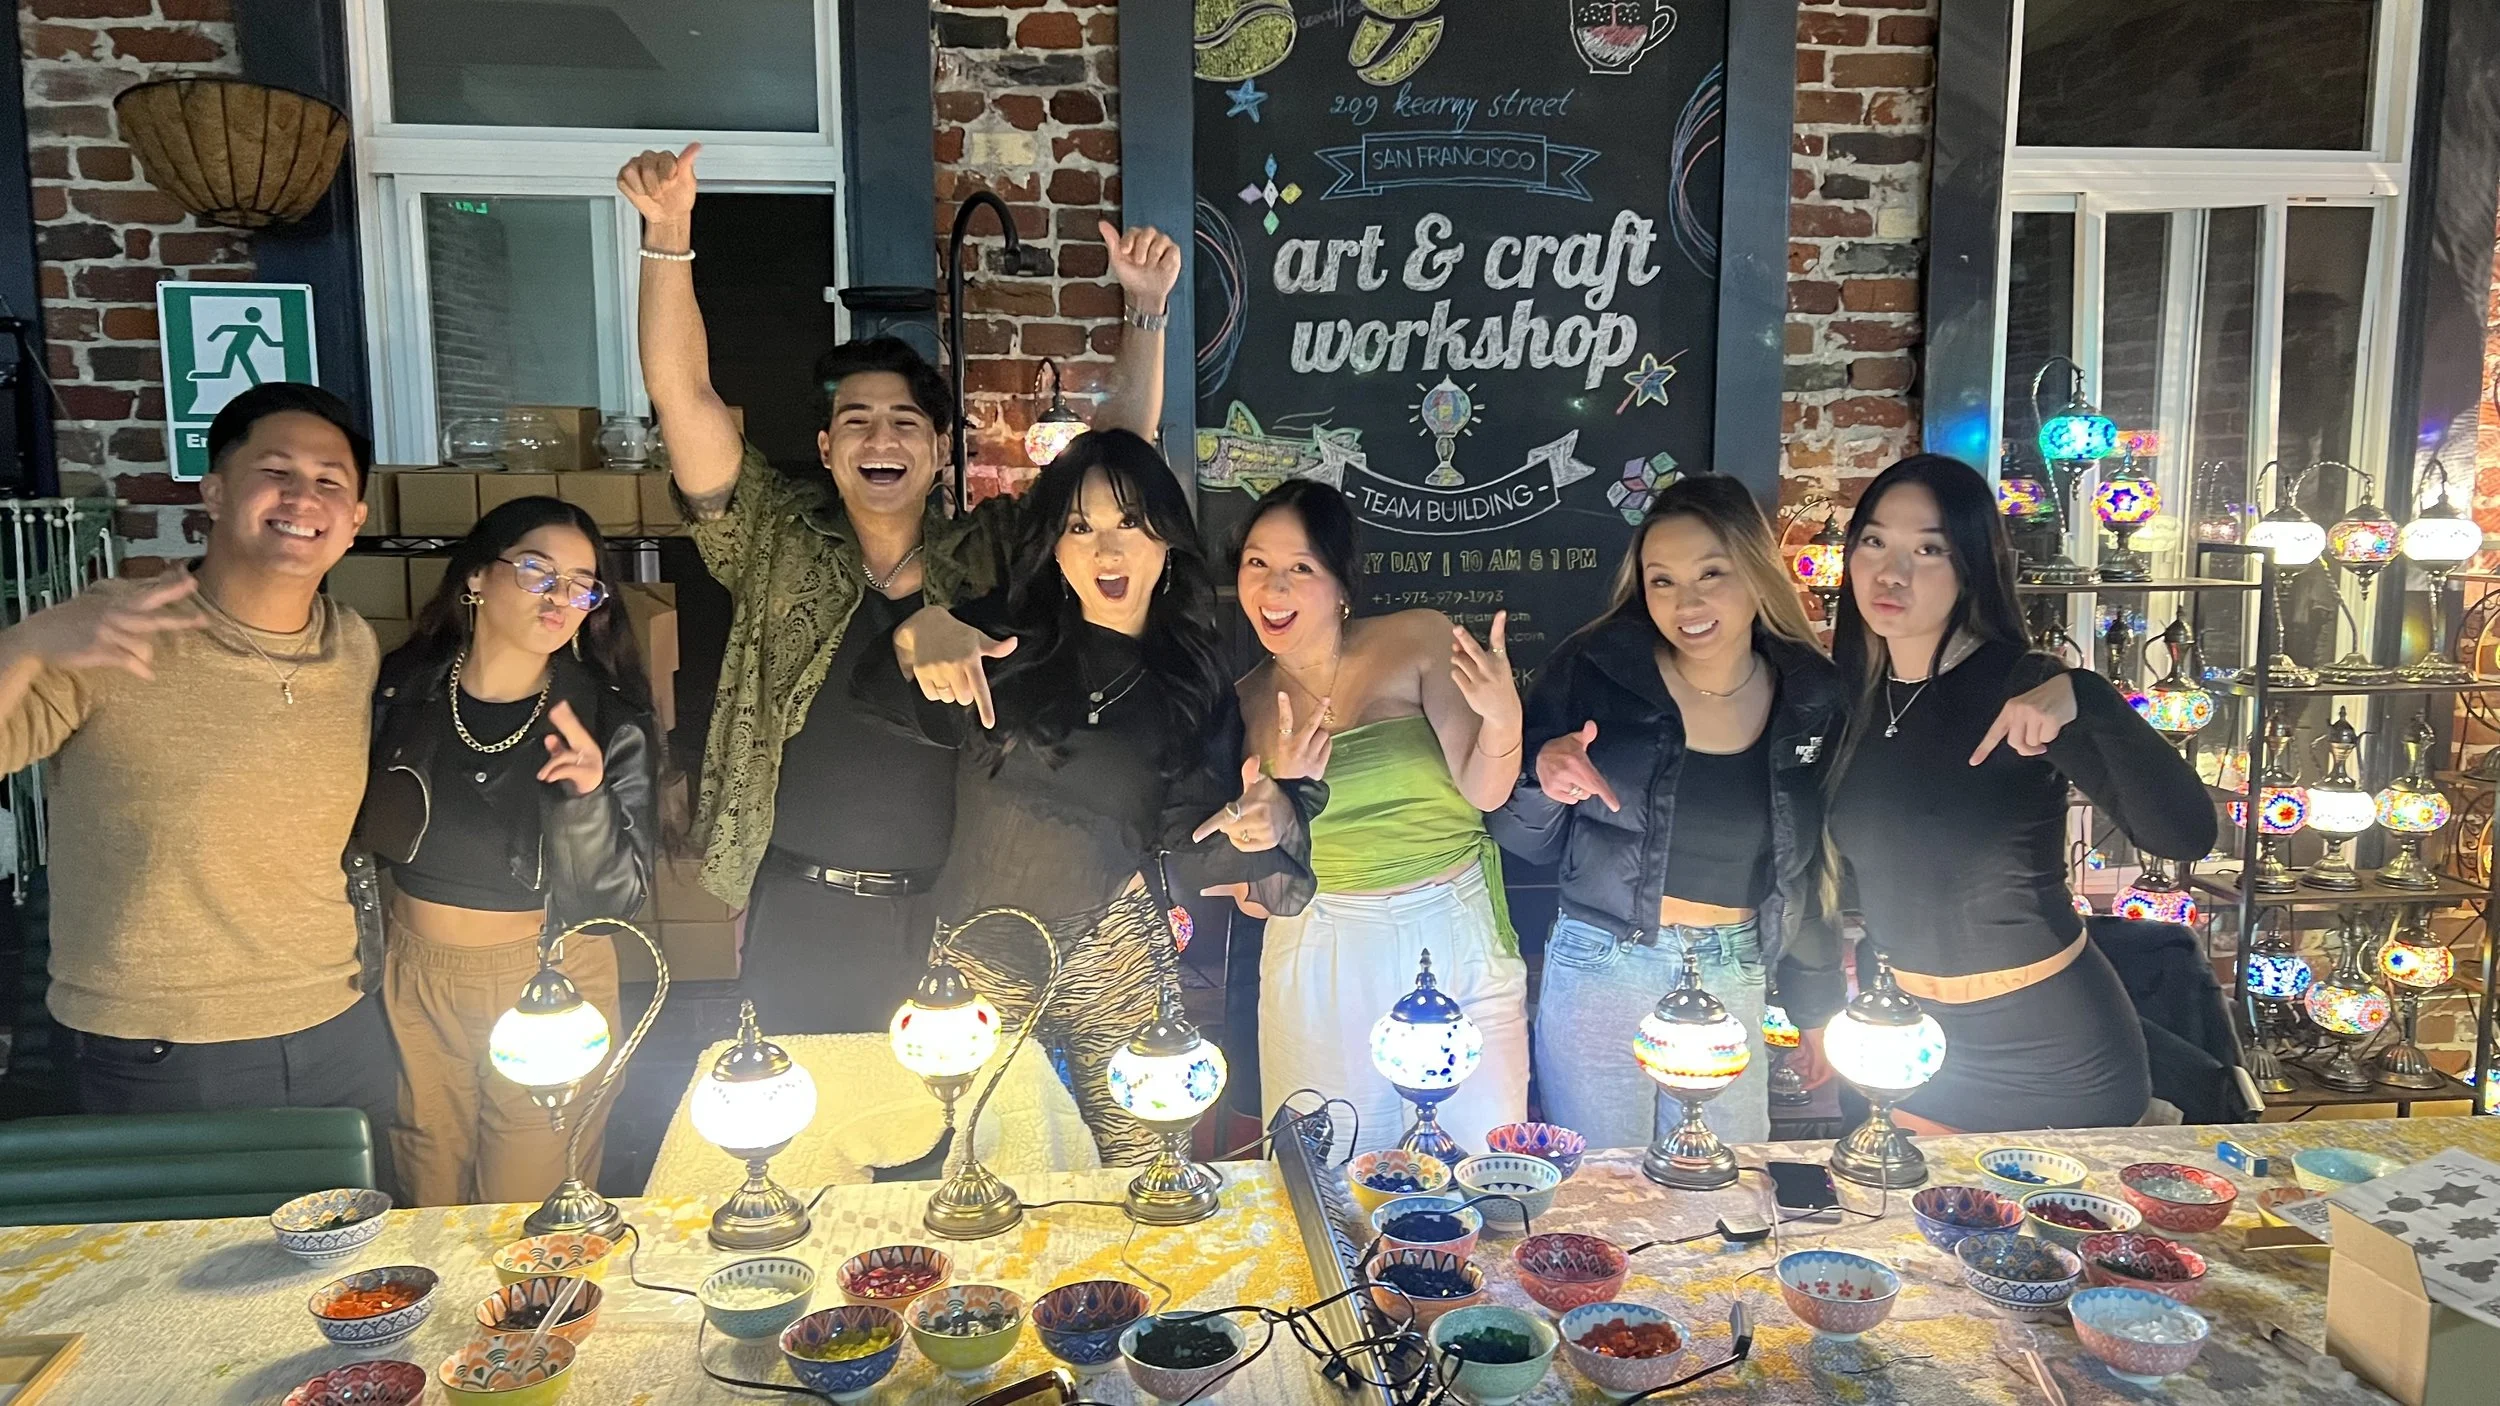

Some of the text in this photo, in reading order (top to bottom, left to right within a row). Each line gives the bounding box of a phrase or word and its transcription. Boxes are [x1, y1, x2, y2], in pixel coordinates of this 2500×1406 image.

[1330, 96, 1378, 125] 209
[1488, 88, 1575, 117] street
[1372, 147, 1536, 171] SAN FRANCISCO
[1273, 210, 1660, 310] art & craft
[1291, 299, 1638, 390] workshop
[1361, 485, 1533, 522] TEAM BUILDING
[1391, 551, 1432, 573] DAY
[1460, 550, 1483, 572] 10
[1488, 549, 1521, 571] AM
[1550, 548, 1560, 570] 1
[1567, 548, 1597, 570] PM
